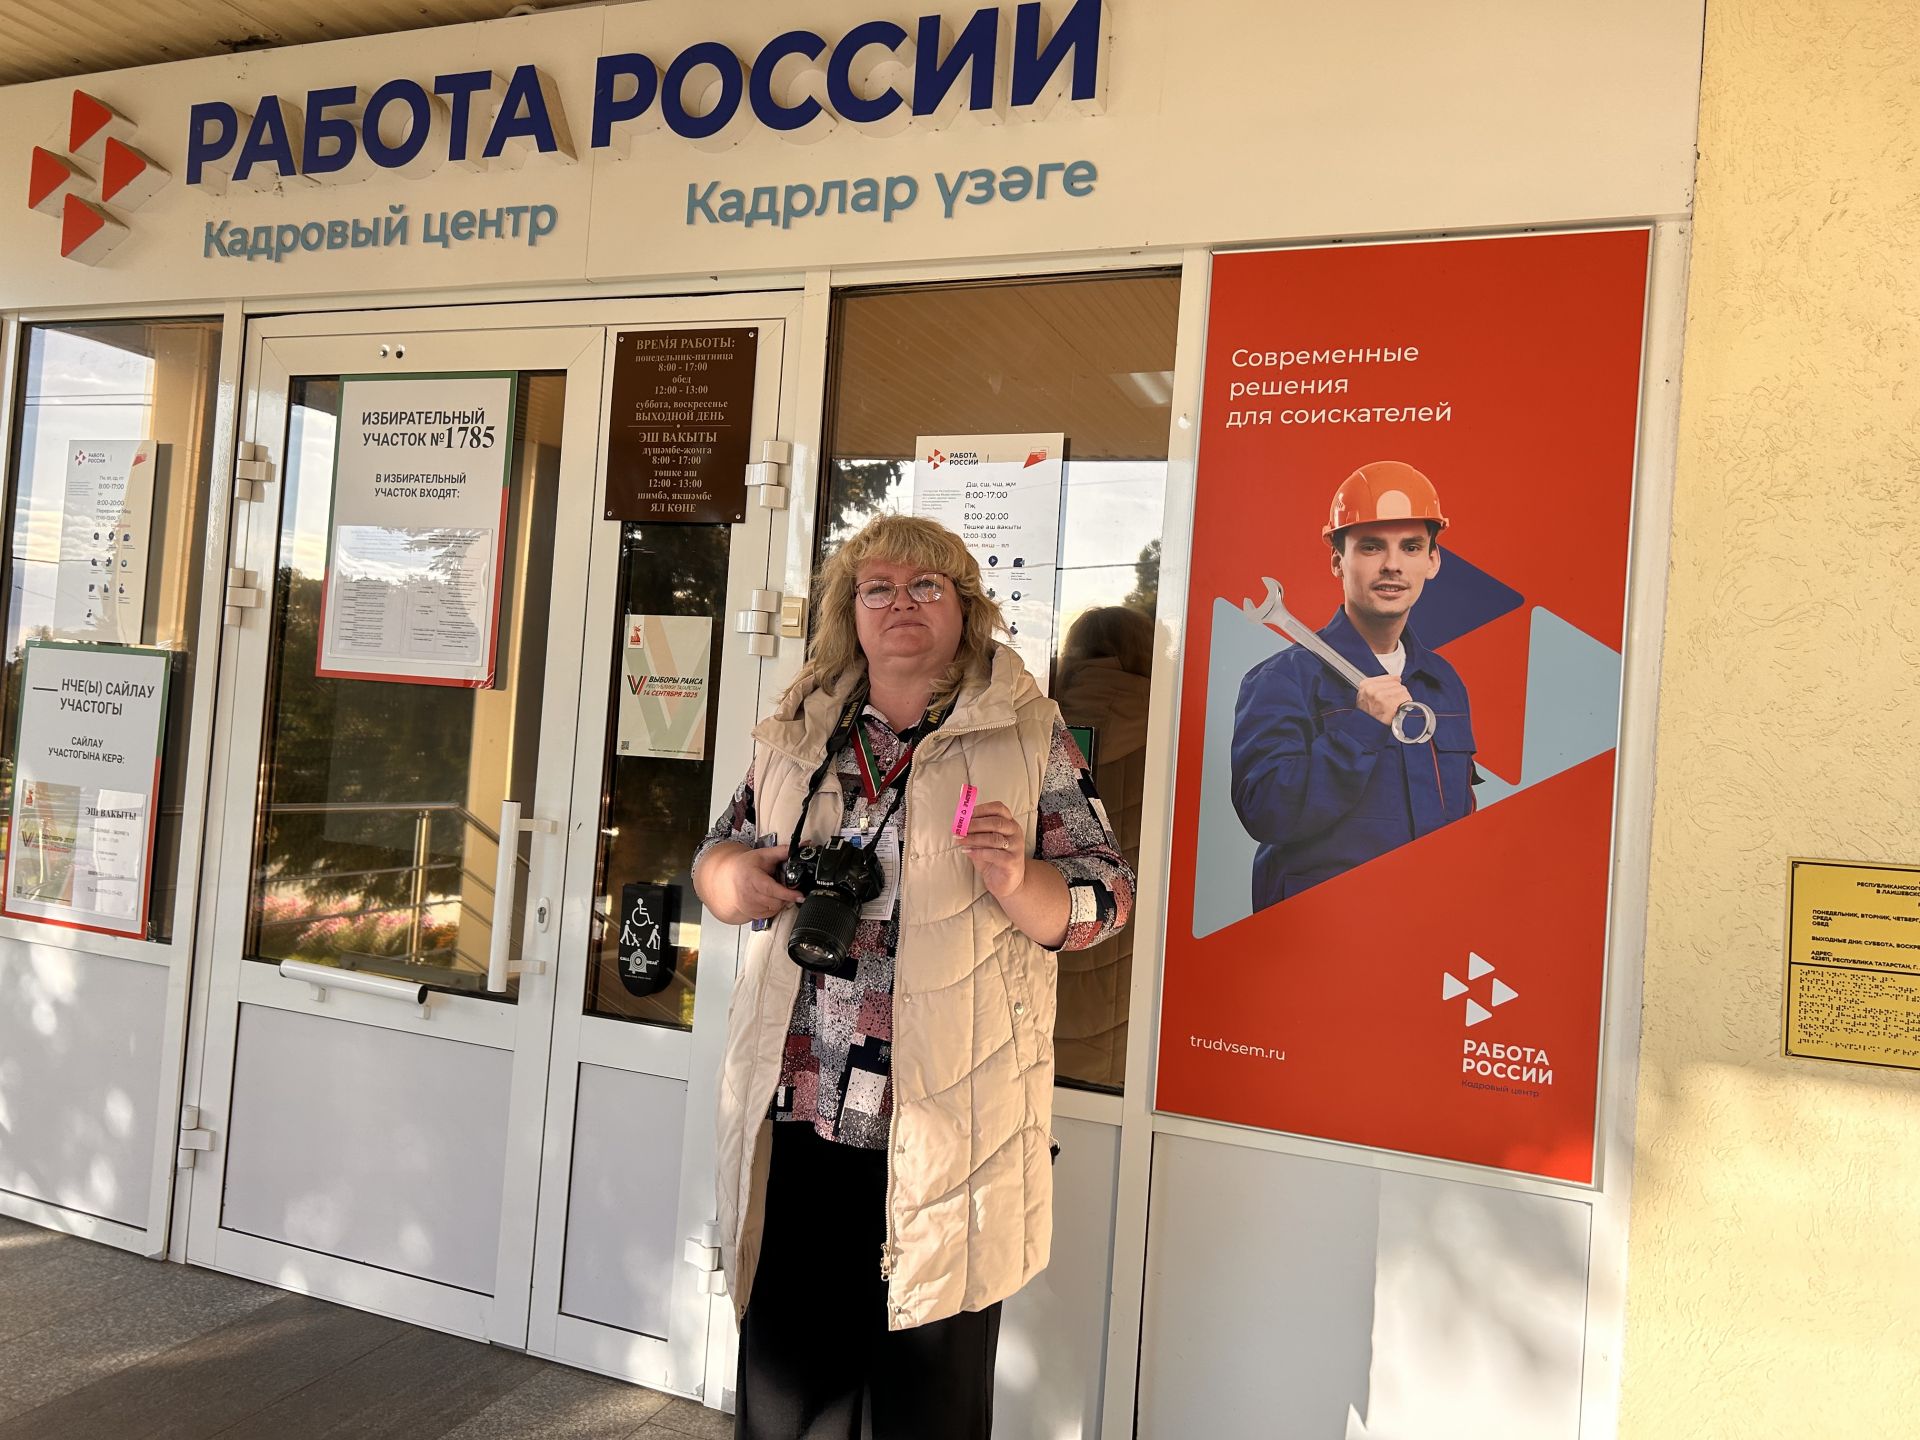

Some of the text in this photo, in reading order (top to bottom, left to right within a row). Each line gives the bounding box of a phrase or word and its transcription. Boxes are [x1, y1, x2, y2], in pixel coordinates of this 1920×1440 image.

[186, 0, 1101, 185] РАБОТА РОССИИ
[686, 159, 1097, 230] Кадрлар үзәге
[203, 203, 559, 263] Кадровый центр
[636, 337, 736, 350] ВРЕМЯ РАБОТЫ:
[635, 352, 734, 363] понедельник-пятница
[1231, 346, 1419, 370] Современные
[658, 363, 676, 372] 8:00
[685, 362, 708, 371] 17:00
[672, 375, 691, 384] обед
[655, 385, 677, 395] 12:00
[685, 385, 708, 394] 13:00
[1229, 378, 1349, 401] решения
[635, 400, 728, 411] суббота, воскресенье
[362, 408, 485, 425] ИЗБИРАТЕЛЬНЫЙ
[635, 410, 724, 422] ВЫХОДНОЙ ДЕНЬ
[1225, 401, 1452, 429] для соискателей
[363, 432, 426, 447] УЧАСТОК
[638, 431, 718, 443] ЭШ ВАКЫТЫ
[651, 456, 670, 465] 8:00
[678, 456, 701, 465] 17:00
[375, 472, 467, 485] В ИЗБИРАТЕЛЬНЫЙ
[654, 469, 682, 477] төшке
[649, 479, 671, 488] 12:00
[679, 479, 702, 488] 13:00
[374, 487, 460, 500] УЧАСТОК ВХОДЯТ:
[671, 491, 712, 501] якшәмбе
[965, 491, 1008, 499] 8:00-17:00
[650, 503, 697, 513] ЯЛ КӨНЕ
[964, 512, 1009, 520] 8:00-20:00
[648, 675, 703, 685] ВЫБОРЫ РАИСА
[61, 678, 155, 699] НЧЕ(Ы) САЙЛАУ
[60, 697, 123, 716] УЧАСТОГЫ
[841, 702, 859, 728] Nikon
[71, 735, 104, 748] САЙЛАУ
[48, 747, 125, 764] УЧАСТОГЫНА КЕРӘ:
[1812, 909, 1860, 919] ПОНЕДЕЛЬНИК,
[1860, 913, 1891, 921] ВТОРНИК,
[1811, 935, 1847, 944] ВЫХОДНЫЕ
[1863, 940, 1895, 949] СУББОТА,
[1832, 957, 1874, 967] РЕСПУБЛИКА
[1874, 960, 1912, 970] ТАТАРСТАН,
[1190, 1035, 1286, 1061] trudvsem.ru
[1463, 1039, 1550, 1066] РАБОТА
[1462, 1057, 1553, 1085] РОССИИ
[1461, 1079, 1540, 1098] Кадровый центр
